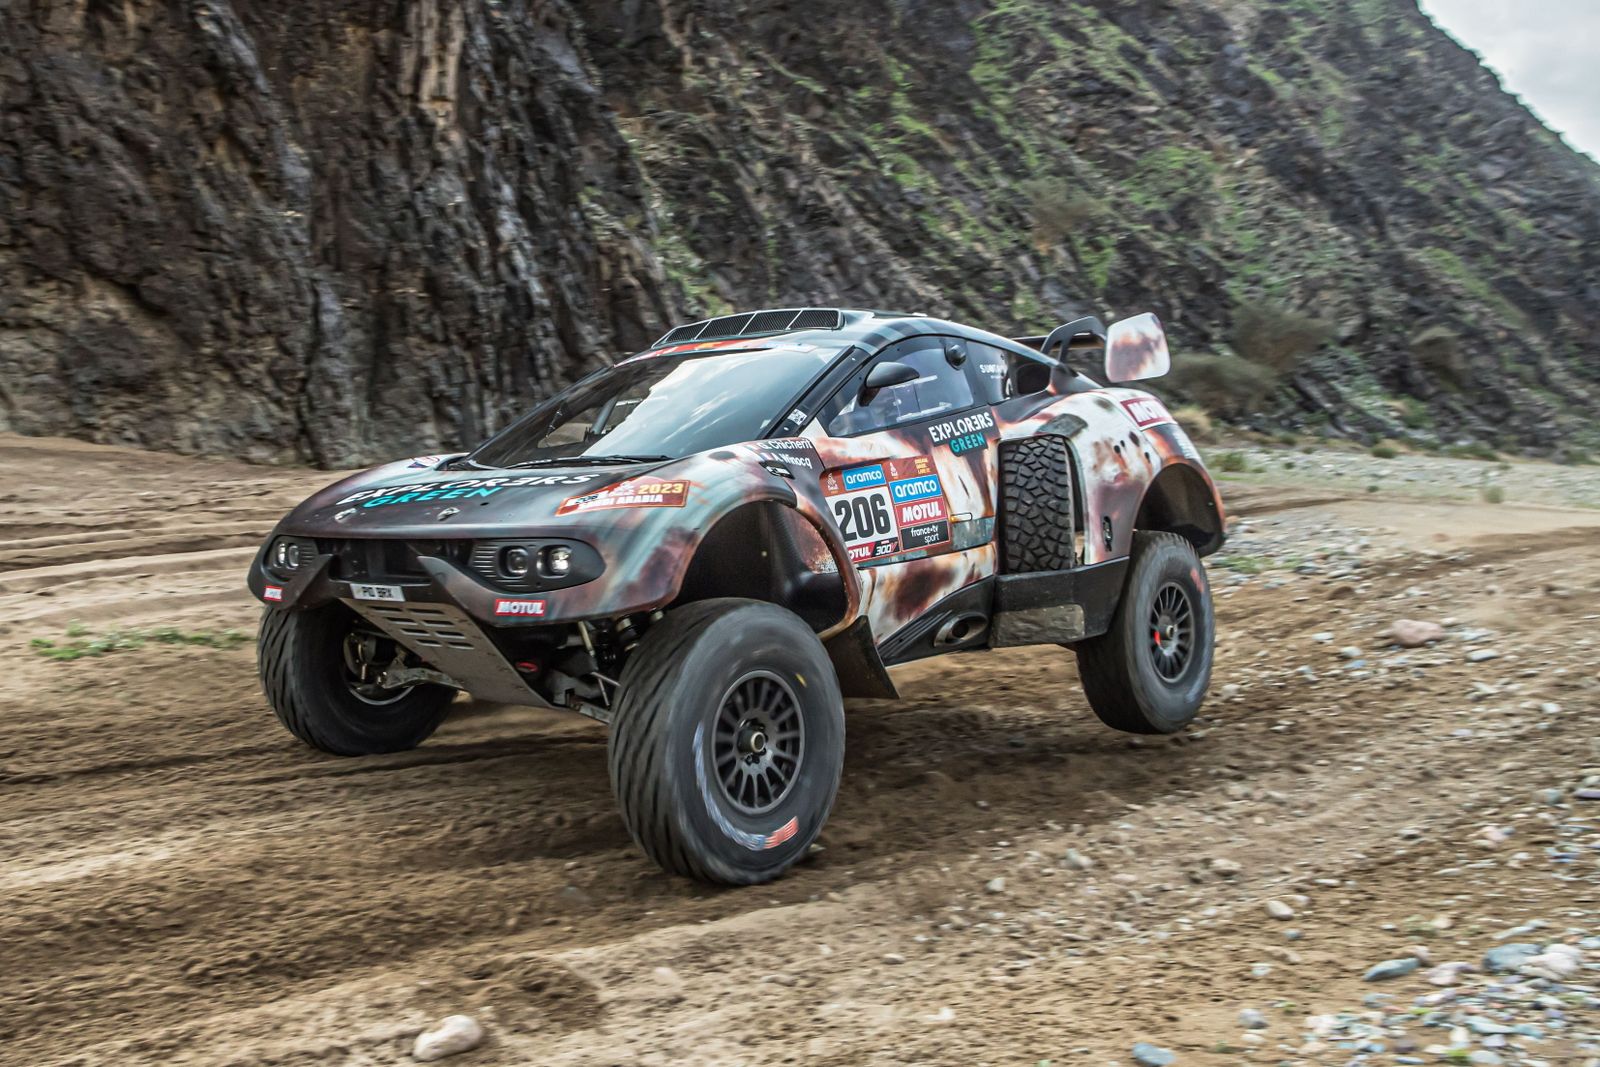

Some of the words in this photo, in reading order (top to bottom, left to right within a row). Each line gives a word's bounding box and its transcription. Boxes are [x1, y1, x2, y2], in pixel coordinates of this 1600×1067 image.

[950, 432, 985, 453] GREEN
[846, 470, 882, 484] aramco
[638, 483, 684, 494] 2023
[895, 480, 937, 498] aramco
[362, 486, 504, 508] GREEN
[615, 494, 664, 505] ARABIA
[835, 493, 891, 541] 206
[902, 501, 942, 523] MOTUL
[924, 533, 940, 545] sport
[848, 547, 872, 560] OTUL
[496, 602, 544, 614] MOTUL
